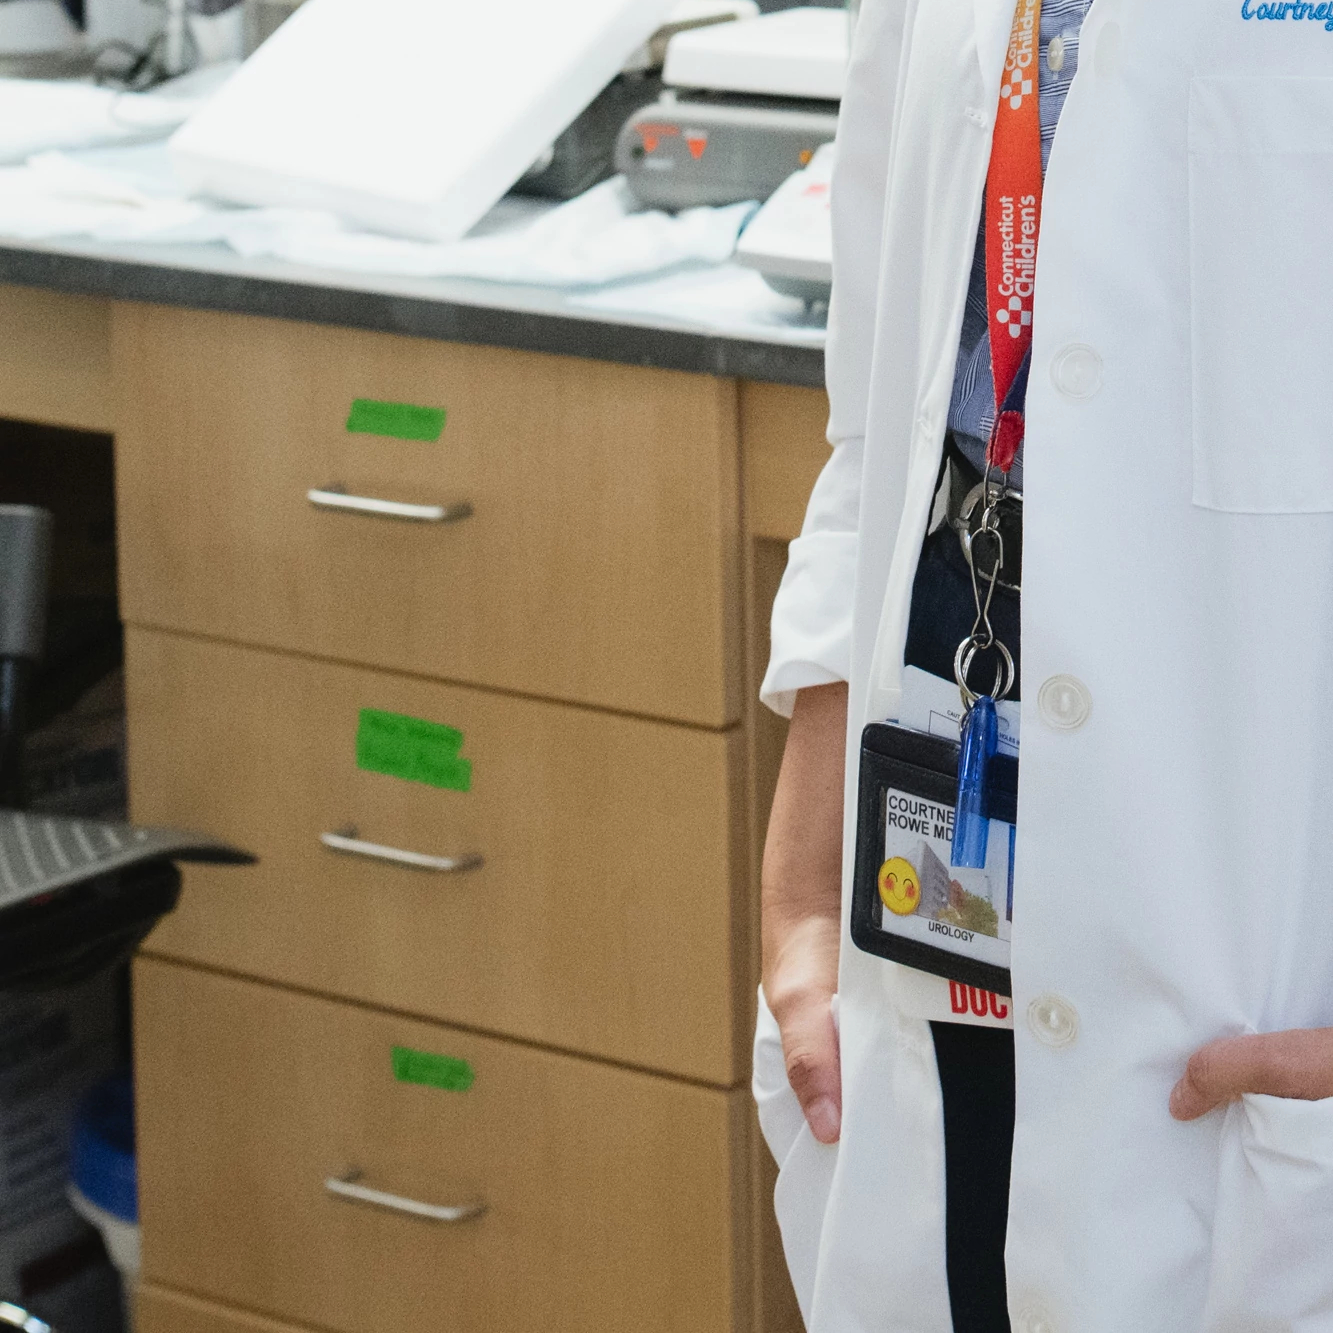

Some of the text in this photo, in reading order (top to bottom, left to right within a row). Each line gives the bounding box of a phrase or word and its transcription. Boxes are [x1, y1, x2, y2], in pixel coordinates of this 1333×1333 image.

[998, 195, 1014, 296] Connecticut
[1015, 194, 1036, 297] Children's
[946, 709, 961, 720] CAUT
[888, 795, 955, 826] COURTNE
[888, 811, 954, 842] ROWE MD
[928, 921, 974, 944] UROLOGY
